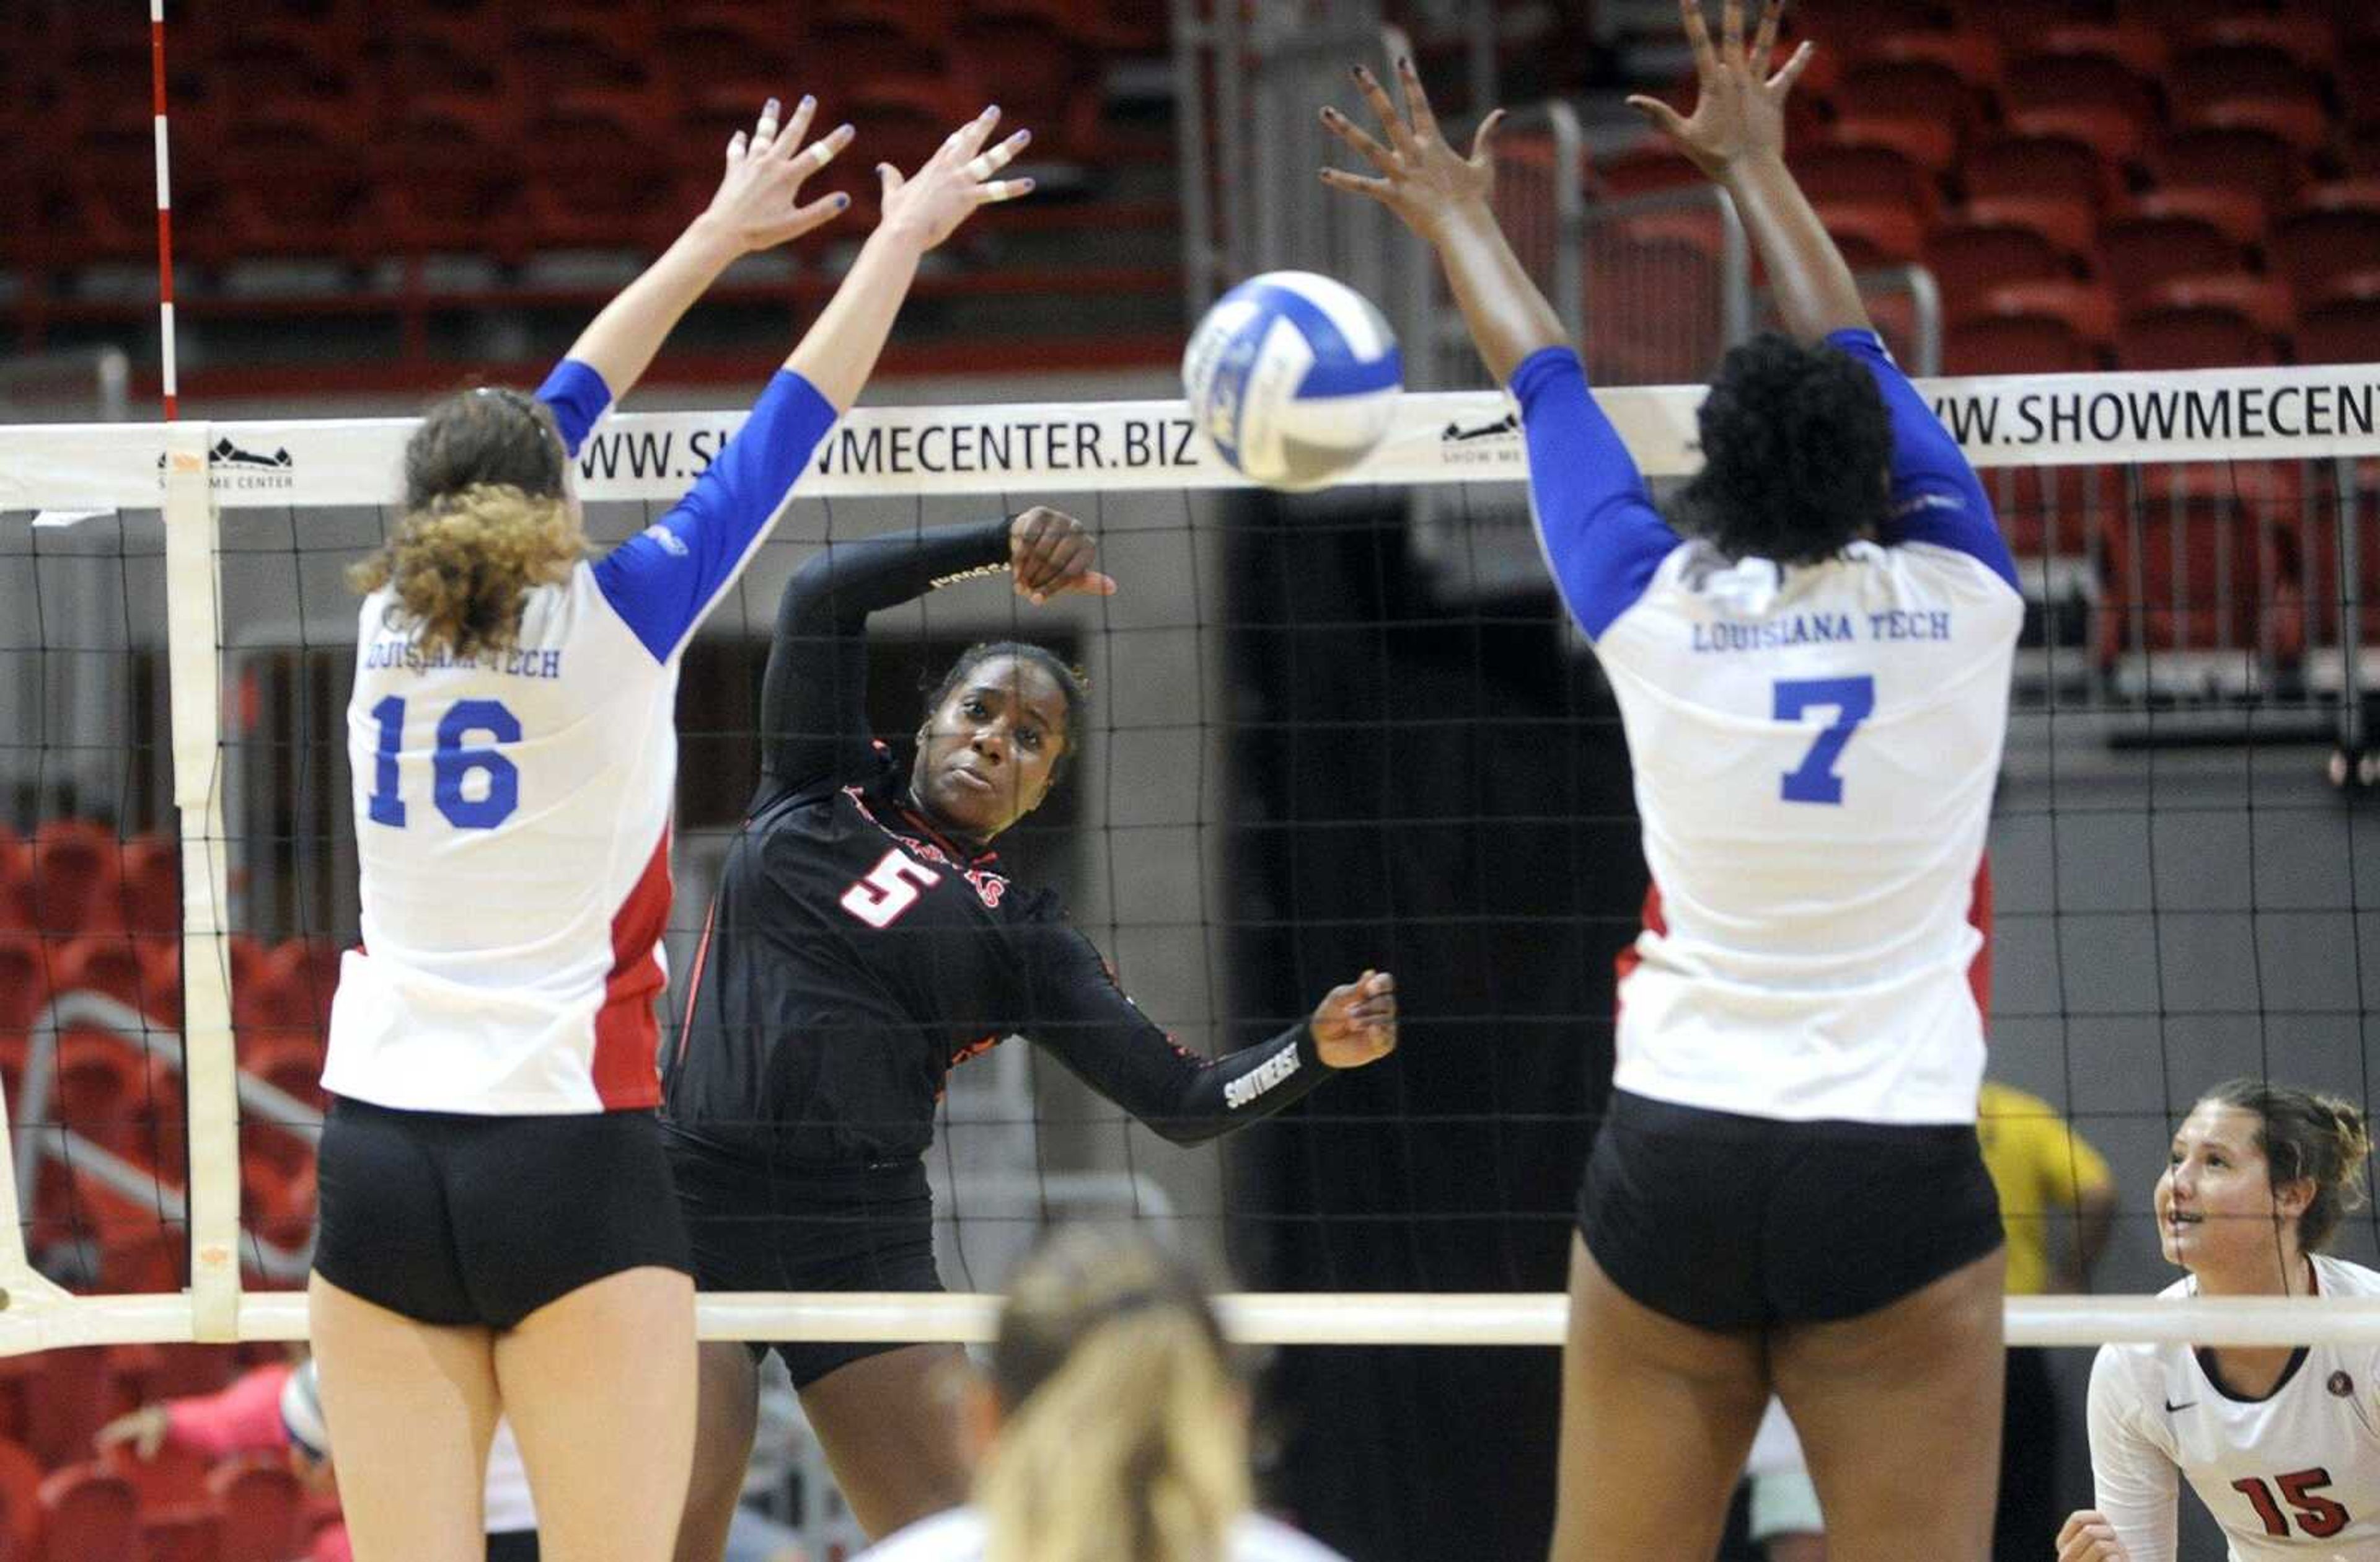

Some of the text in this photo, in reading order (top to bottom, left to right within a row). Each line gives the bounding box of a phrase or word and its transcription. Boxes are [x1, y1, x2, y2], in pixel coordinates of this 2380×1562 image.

[1934, 384, 2380, 445] W.SHOWMECEN
[237, 475, 293, 489] CENTER
[1693, 611, 1949, 651] LOUISIANA TECH
[369, 694, 521, 829] 16
[1773, 674, 1875, 804] 7
[840, 847, 942, 929] 5
[2231, 1467, 2350, 1538] 15
